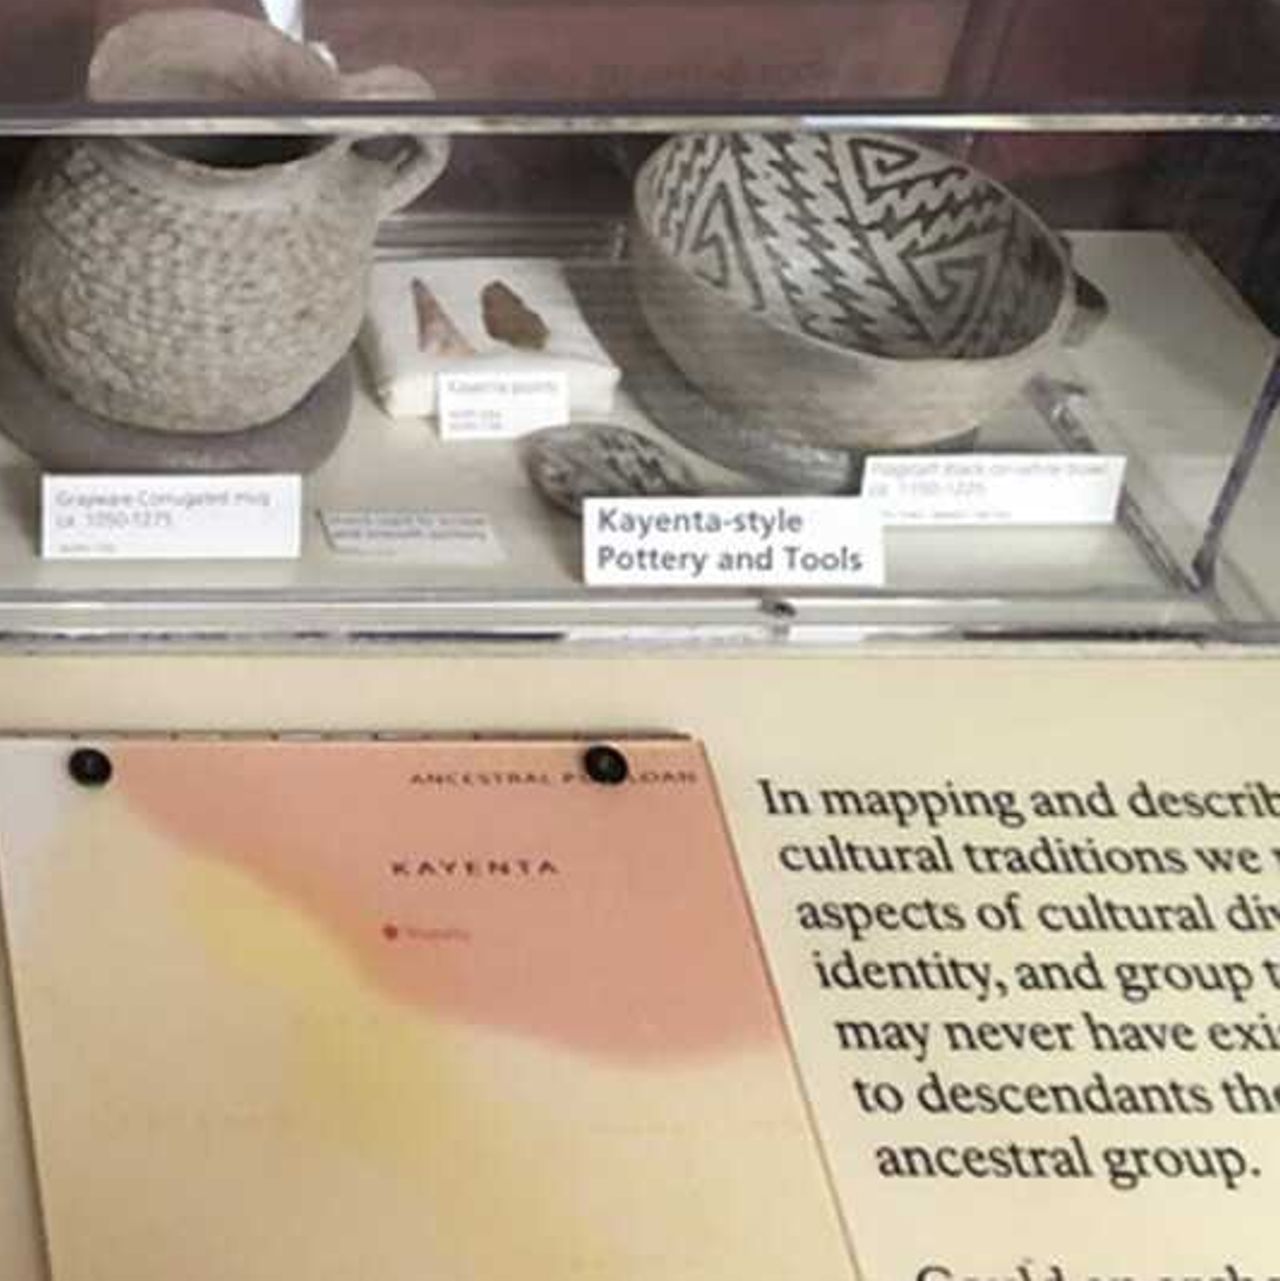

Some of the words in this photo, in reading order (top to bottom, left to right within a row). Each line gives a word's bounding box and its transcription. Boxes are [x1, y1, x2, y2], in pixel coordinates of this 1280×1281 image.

[599, 508, 802, 539] Kayenta-style
[599, 546, 707, 577] Pottery
[718, 546, 773, 570] and
[783, 546, 862, 571] Tools
[759, 780, 809, 814] In
[820, 782, 1025, 828] mapping
[1030, 781, 1118, 817] and
[391, 860, 558, 876] KAYENTA
[780, 835, 953, 872] cultural
[963, 837, 1187, 874] traditions
[1194, 849, 1261, 874] we
[797, 900, 965, 941] aspects
[977, 892, 1022, 930] of
[1038, 893, 1215, 931] cultural
[813, 950, 1007, 1001] identity,
[1015, 952, 1105, 990] and
[1115, 963, 1253, 1002] group
[835, 1022, 929, 1062] may
[944, 1023, 1080, 1051] never
[1082, 1012, 1196, 1051] have
[876, 1136, 1092, 1177] ancestral
[1103, 1148, 1260, 1190] group.
